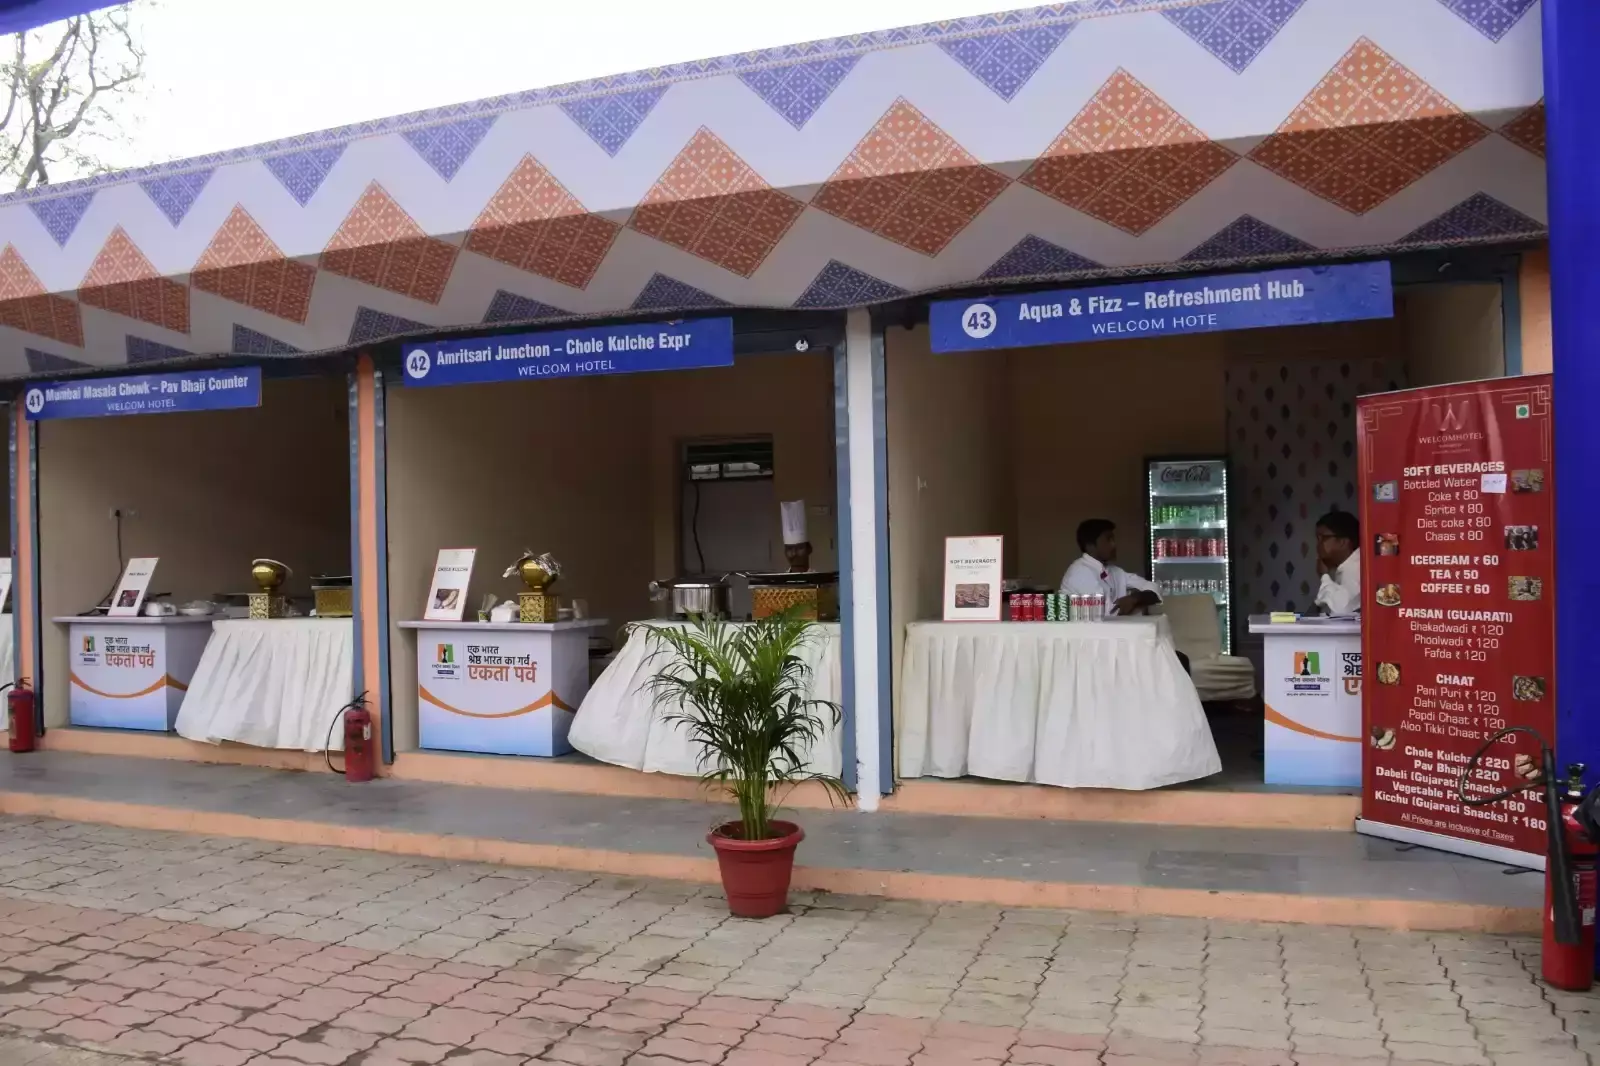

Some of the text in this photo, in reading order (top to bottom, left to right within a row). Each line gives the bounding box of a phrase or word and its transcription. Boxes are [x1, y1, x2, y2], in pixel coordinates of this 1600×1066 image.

[967, 311, 991, 330] 43
[1018, 302, 1063, 322] Aqua
[1069, 299, 1082, 315] &
[1088, 295, 1122, 314] Fizz
[1144, 283, 1261, 309] Refreshment
[1267, 280, 1305, 299] Hub
[1092, 313, 1217, 334] WELCOM HOTE
[410, 356, 427, 372] 42
[436, 346, 491, 366] Amritsari
[495, 343, 550, 361] Junction
[566, 338, 603, 355] Chole
[608, 334, 654, 351] Kulche
[659, 332, 691, 350] Expr
[518, 360, 615, 376] WELCOM HOTEL
[29, 395, 42, 407] 41
[46, 388, 81, 401] Mumbai
[84, 385, 117, 398] Masala
[119, 382, 150, 397] Chowk
[161, 380, 179, 393] Pav
[181, 378, 206, 394] Bhaji
[208, 376, 248, 391] Counter
[107, 399, 176, 411] WELCOM HOTEL
[1419, 432, 1483, 444] WELCOMHOTEL
[1404, 461, 1505, 477] SOFT BEVERAGES
[1404, 479, 1440, 490] Bottled
[1444, 477, 1478, 488] Water
[1429, 491, 1451, 502] Coke
[1463, 490, 1478, 500] 80
[1425, 504, 1455, 516] Sprite
[1468, 503, 1483, 514] 80
[1418, 518, 1438, 529] Diet
[1441, 517, 1464, 528] coke
[1476, 516, 1491, 527] 80
[1425, 531, 1456, 541] Chaas
[1468, 530, 1483, 541] 80
[1411, 555, 1470, 566] ICECREAM
[1482, 555, 1499, 566] 60
[1430, 569, 1451, 579] TEA
[1463, 569, 1478, 579] 50
[1421, 583, 1463, 594] COFFEE
[1474, 583, 1490, 594] 60
[1399, 608, 1513, 623] FARSAN (GUJARATI)
[1410, 621, 1468, 633] Bhakadwadi
[1481, 624, 1504, 636] 120
[1414, 634, 1464, 646] Phoolwadi
[1477, 637, 1499, 649] 120
[467, 645, 499, 655] एक भारत
[1425, 647, 1452, 659] Fafda
[1465, 650, 1486, 661] 120
[105, 650, 156, 668] एकता पर्व
[468, 654, 530, 665] श्रेष्ठ भारत का गर्व
[467, 661, 537, 683] एकता पर्व
[1436, 674, 1475, 686] CHAAT
[1416, 685, 1437, 697] Pani
[1440, 687, 1462, 699] Puri
[1474, 690, 1496, 702] 120
[1414, 697, 1436, 708] Dahi
[1439, 700, 1464, 712] Vada
[1477, 704, 1499, 716] 120
[1408, 709, 1435, 722] Papdi
[1438, 712, 1469, 725] Chaat
[1483, 717, 1505, 730] 120
[1400, 720, 1421, 732] Aloo
[1424, 723, 1445, 735] Tikki
[1448, 726, 1480, 740] Chaat
[1405, 745, 1433, 758] Chole
[1485, 757, 1510, 770] 220
[1376, 766, 1408, 780] Dabeli
[1411, 772, 1458, 788] (Gujarati
[1414, 759, 1433, 771] Pav
[1437, 763, 1464, 777] Bhaji
[1476, 768, 1500, 782] 220
[1392, 781, 1443, 798] Vegetable
[1501, 799, 1526, 813] 180
[1375, 790, 1408, 805] Kicchu
[1412, 796, 1460, 814] (Gujarati
[1464, 805, 1508, 823] Snacks)
[1522, 816, 1547, 831] 180
[1401, 812, 1410, 822] All
[1412, 814, 1433, 827] Prices
[1435, 819, 1447, 828] are
[1482, 828, 1490, 837] of
[1492, 830, 1514, 841] Taxes
